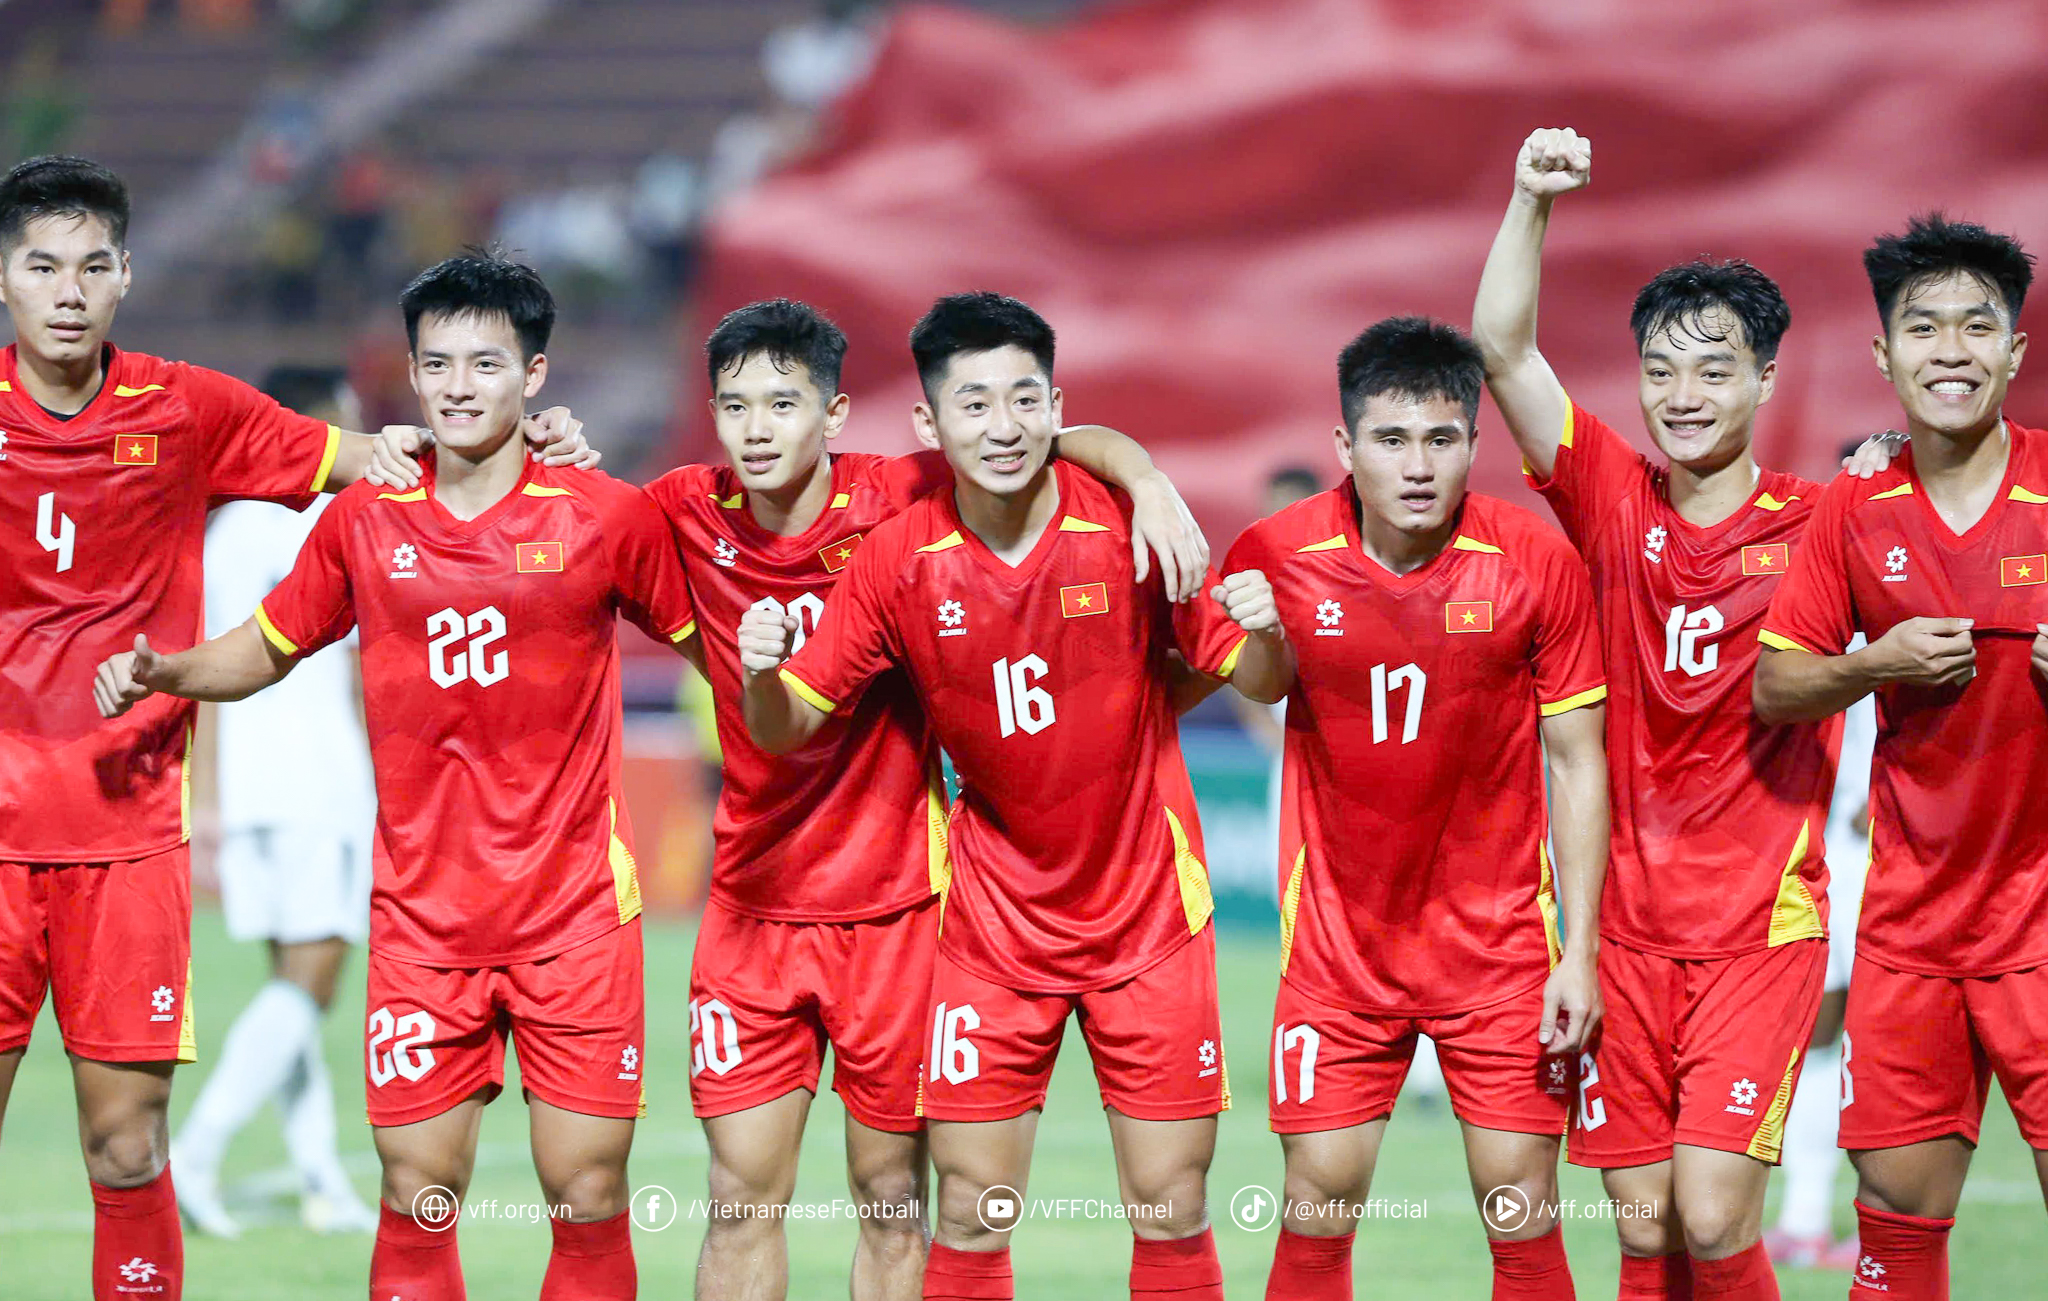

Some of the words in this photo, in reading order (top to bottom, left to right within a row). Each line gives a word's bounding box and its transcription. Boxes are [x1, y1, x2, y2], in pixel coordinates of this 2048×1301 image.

[35, 491, 76, 573] 4
[426, 605, 510, 690] 22
[749, 591, 825, 664] 0
[1663, 604, 1725, 678] 12
[992, 652, 1056, 739] 16
[1370, 662, 1427, 745] 17
[367, 1006, 437, 1088] 22
[929, 1001, 981, 1086] 16
[1274, 1022, 1321, 1105] 17
[1576, 1052, 1607, 1132] 2
